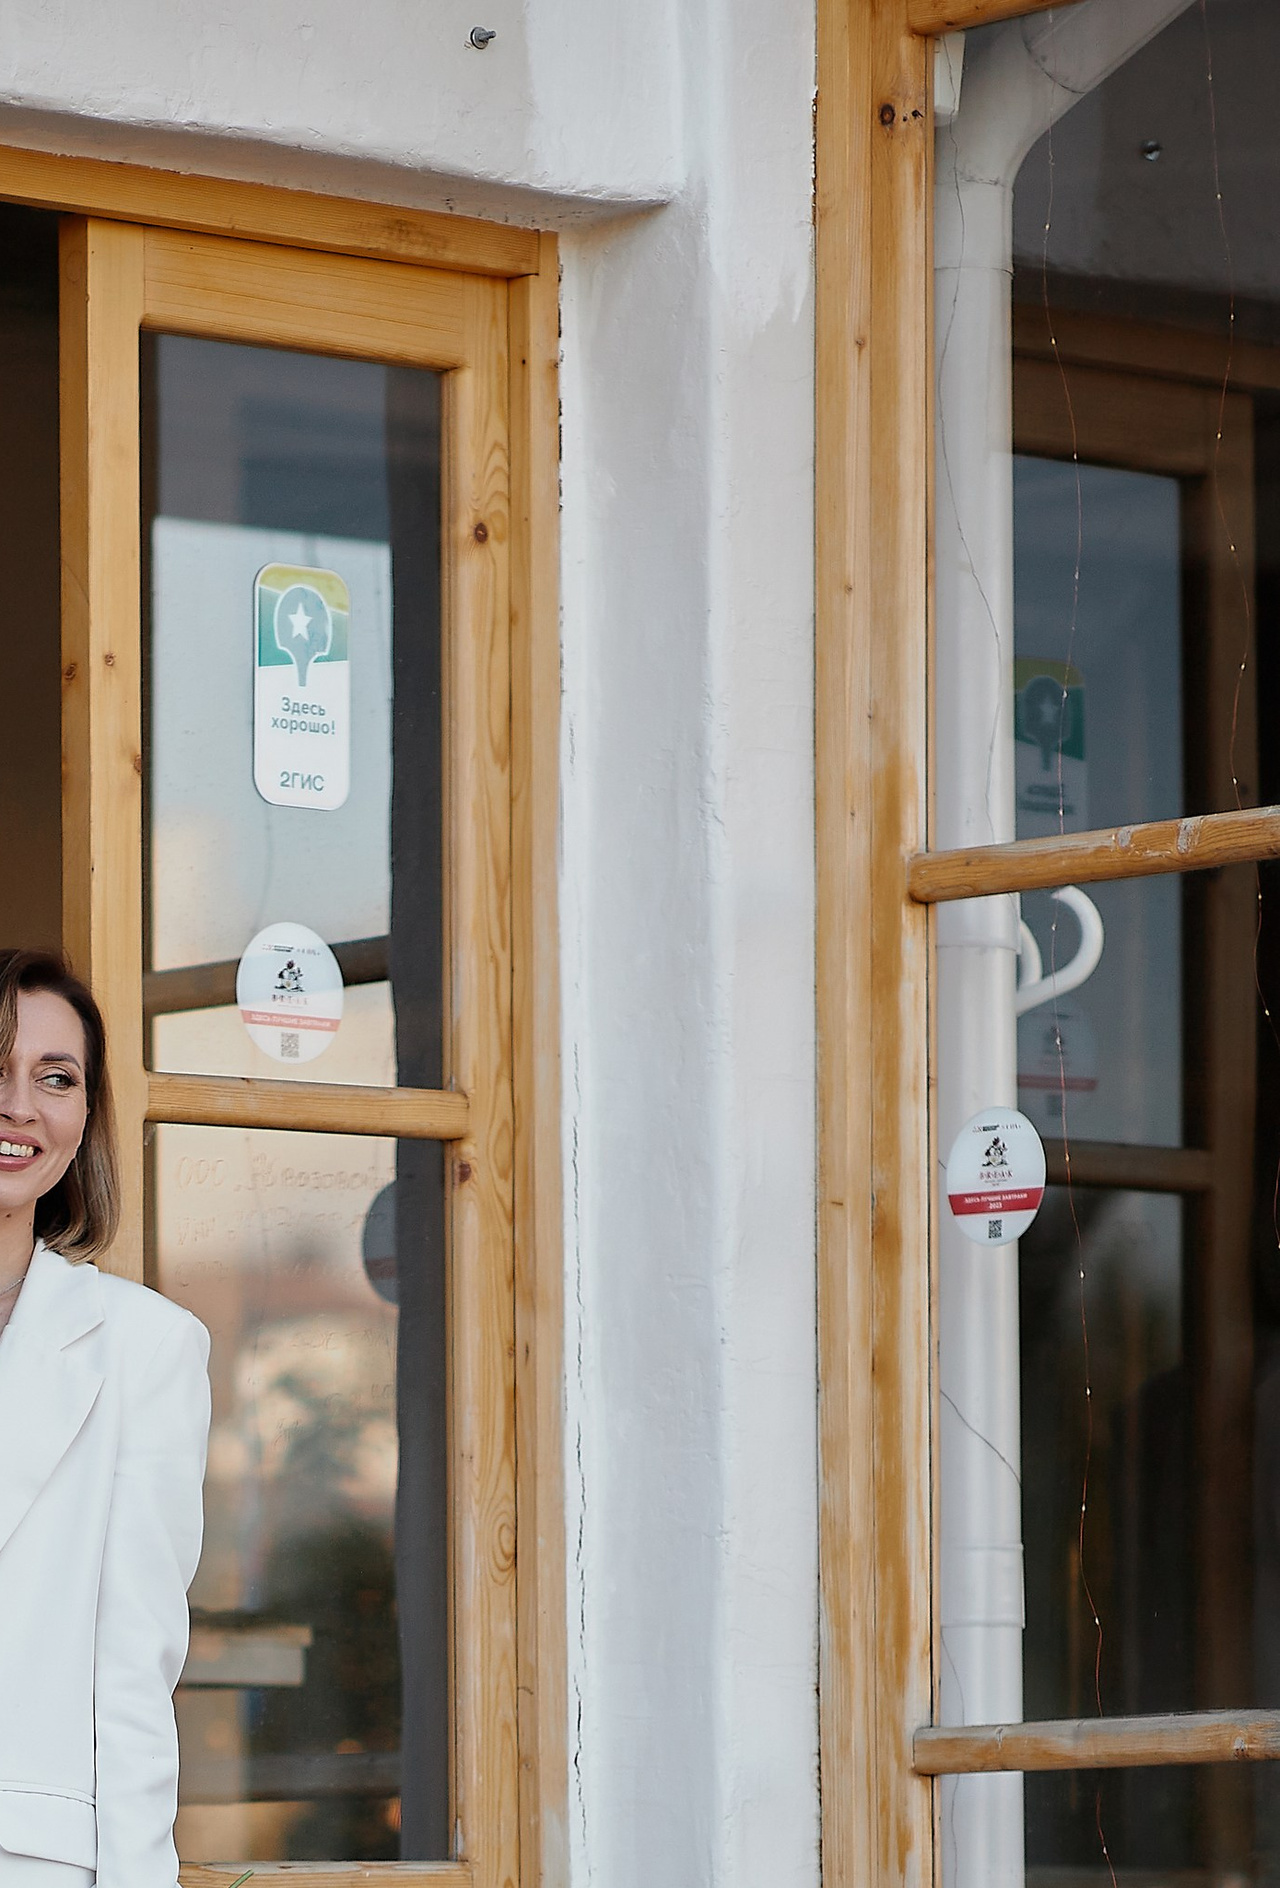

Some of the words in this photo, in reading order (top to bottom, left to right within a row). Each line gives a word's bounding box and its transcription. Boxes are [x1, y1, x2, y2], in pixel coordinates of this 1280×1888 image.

[281, 696, 326, 716] Здесь
[271, 717, 336, 735] хорошо!
[280, 771, 325, 792] 2ГИС
